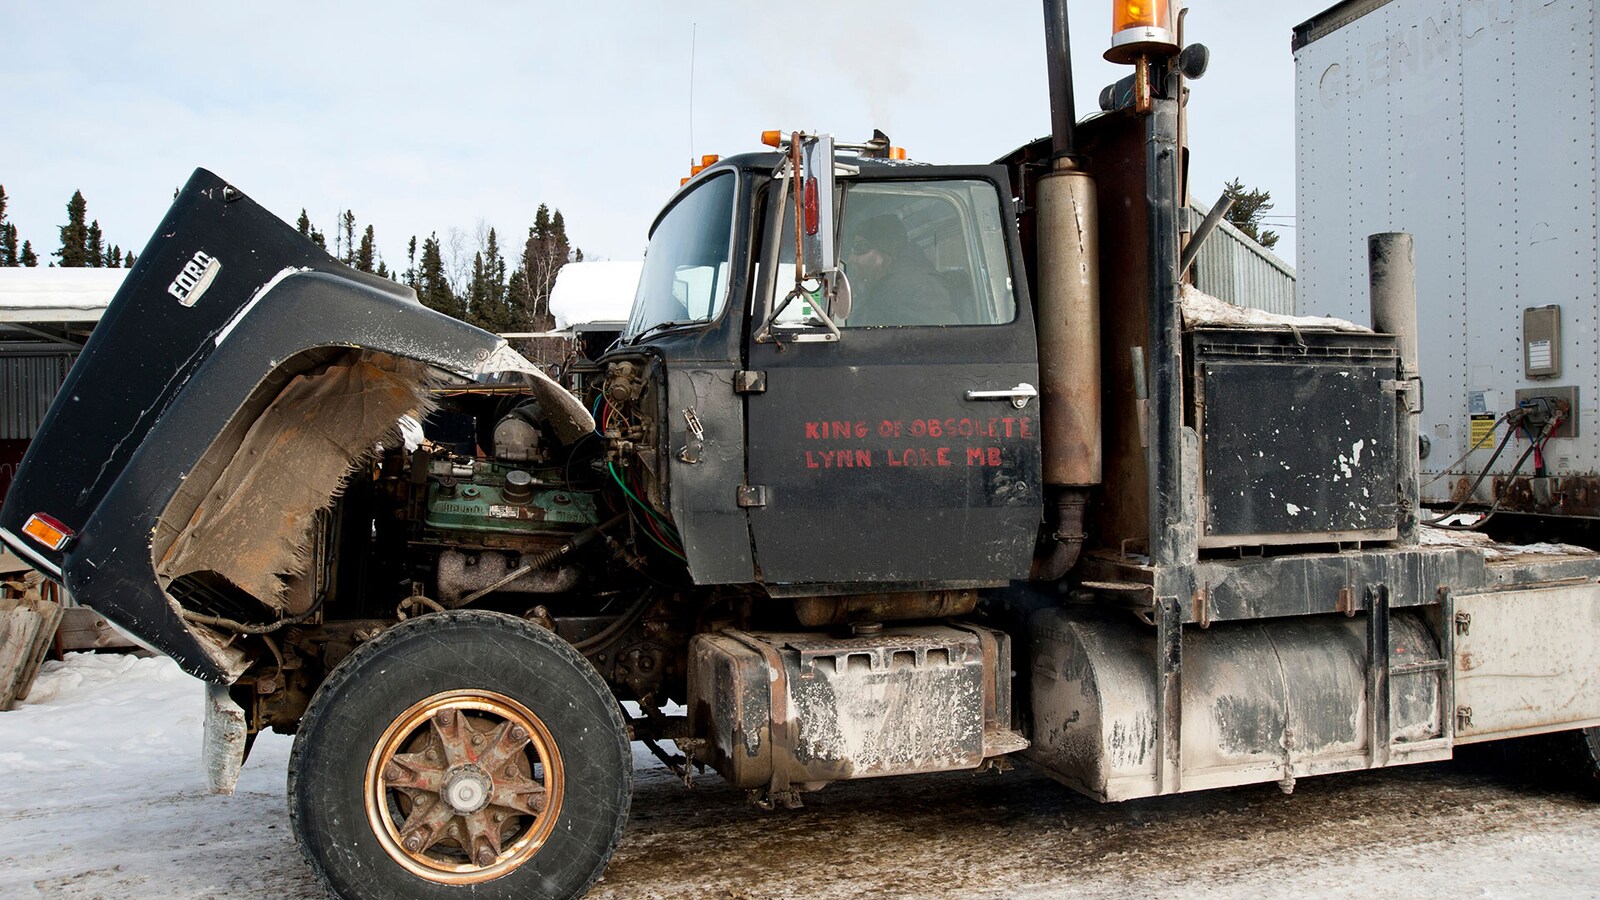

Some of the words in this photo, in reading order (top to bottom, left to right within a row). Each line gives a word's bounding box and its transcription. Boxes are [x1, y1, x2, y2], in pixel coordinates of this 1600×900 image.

[168, 250, 213, 302] FORD
[805, 421, 869, 439] KING
[878, 419, 902, 438] OF
[911, 417, 1032, 439] OBSOLETE
[805, 450, 871, 469] LYNN
[888, 447, 951, 467] LAKE
[967, 447, 1002, 467] MB
